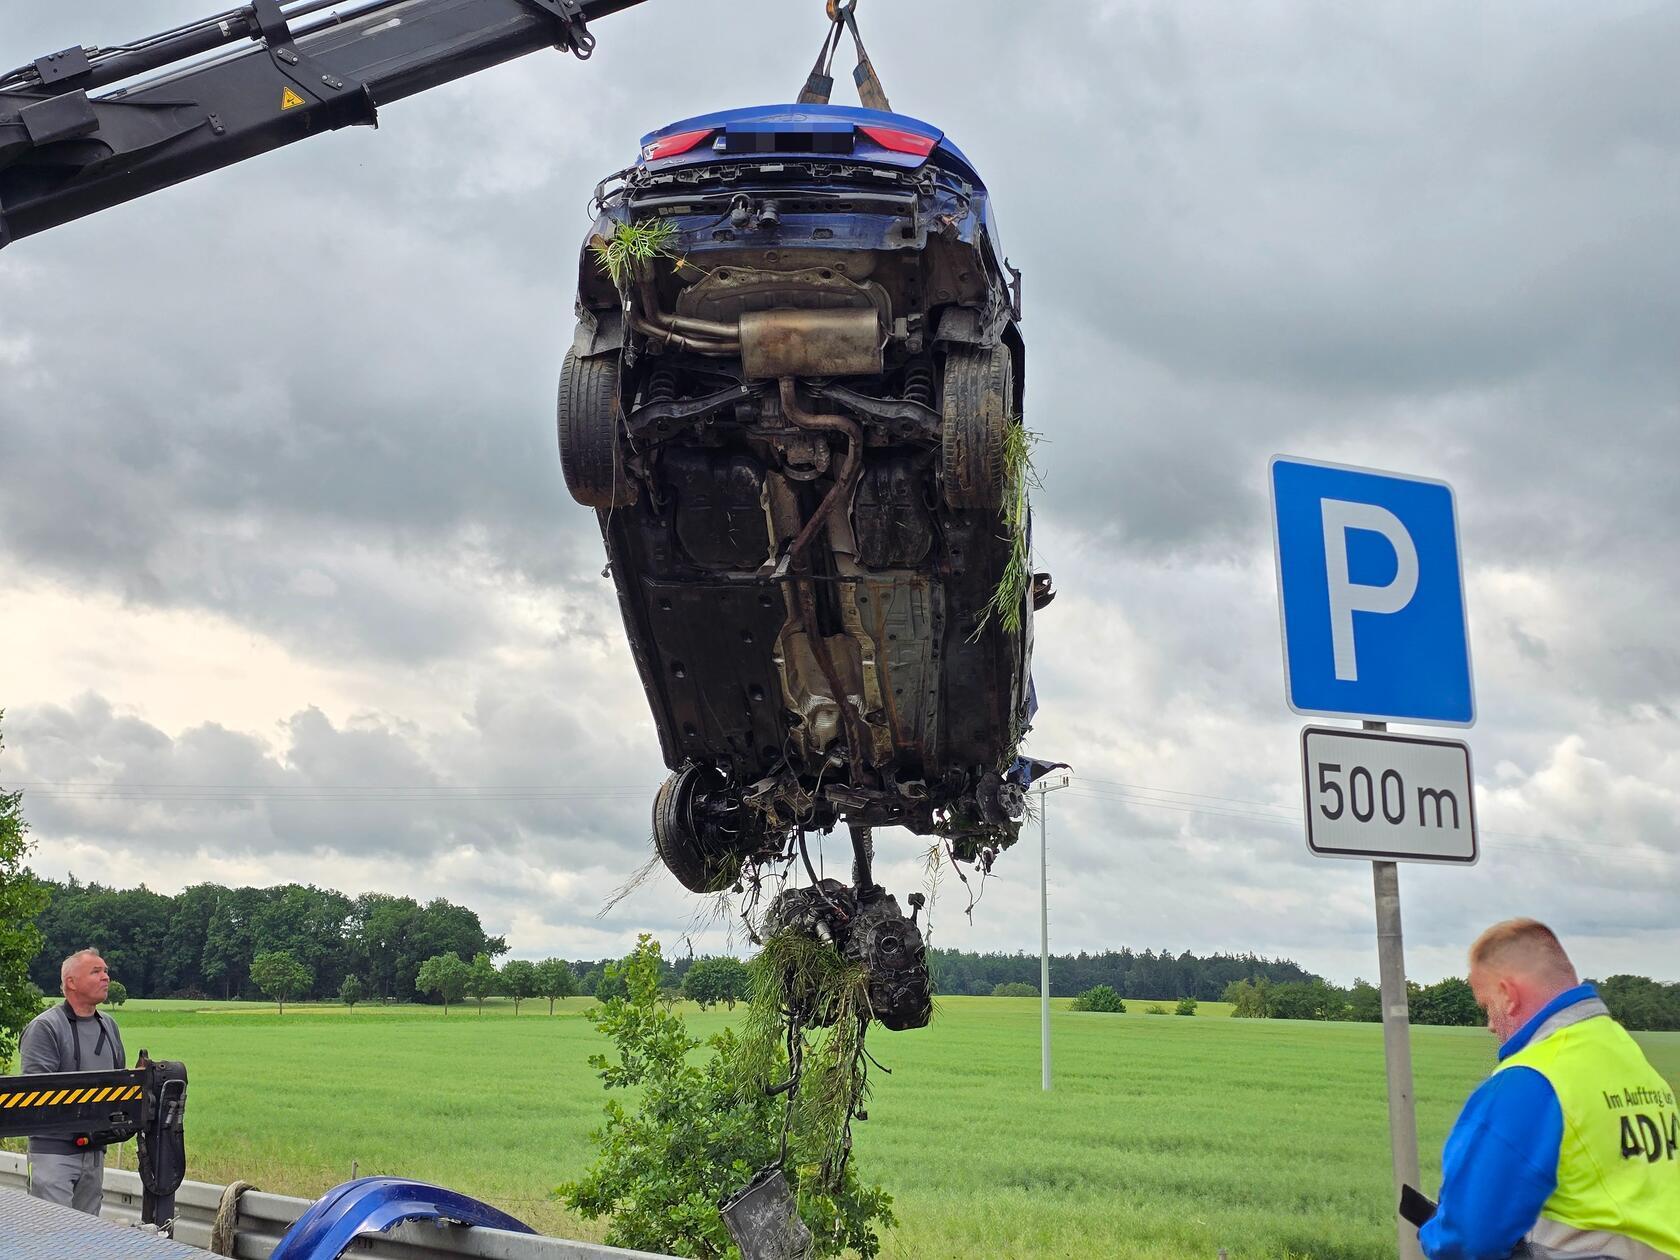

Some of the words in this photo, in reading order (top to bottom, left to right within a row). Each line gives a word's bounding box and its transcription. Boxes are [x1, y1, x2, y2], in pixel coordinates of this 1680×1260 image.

[1320, 498, 1419, 682] P
[1318, 762, 1406, 825] 500
[1417, 786, 1460, 829] m
[1602, 1090, 1623, 1110] Im
[1624, 1086, 1664, 1108] Auftrag
[1620, 1111, 1680, 1165] ADA
